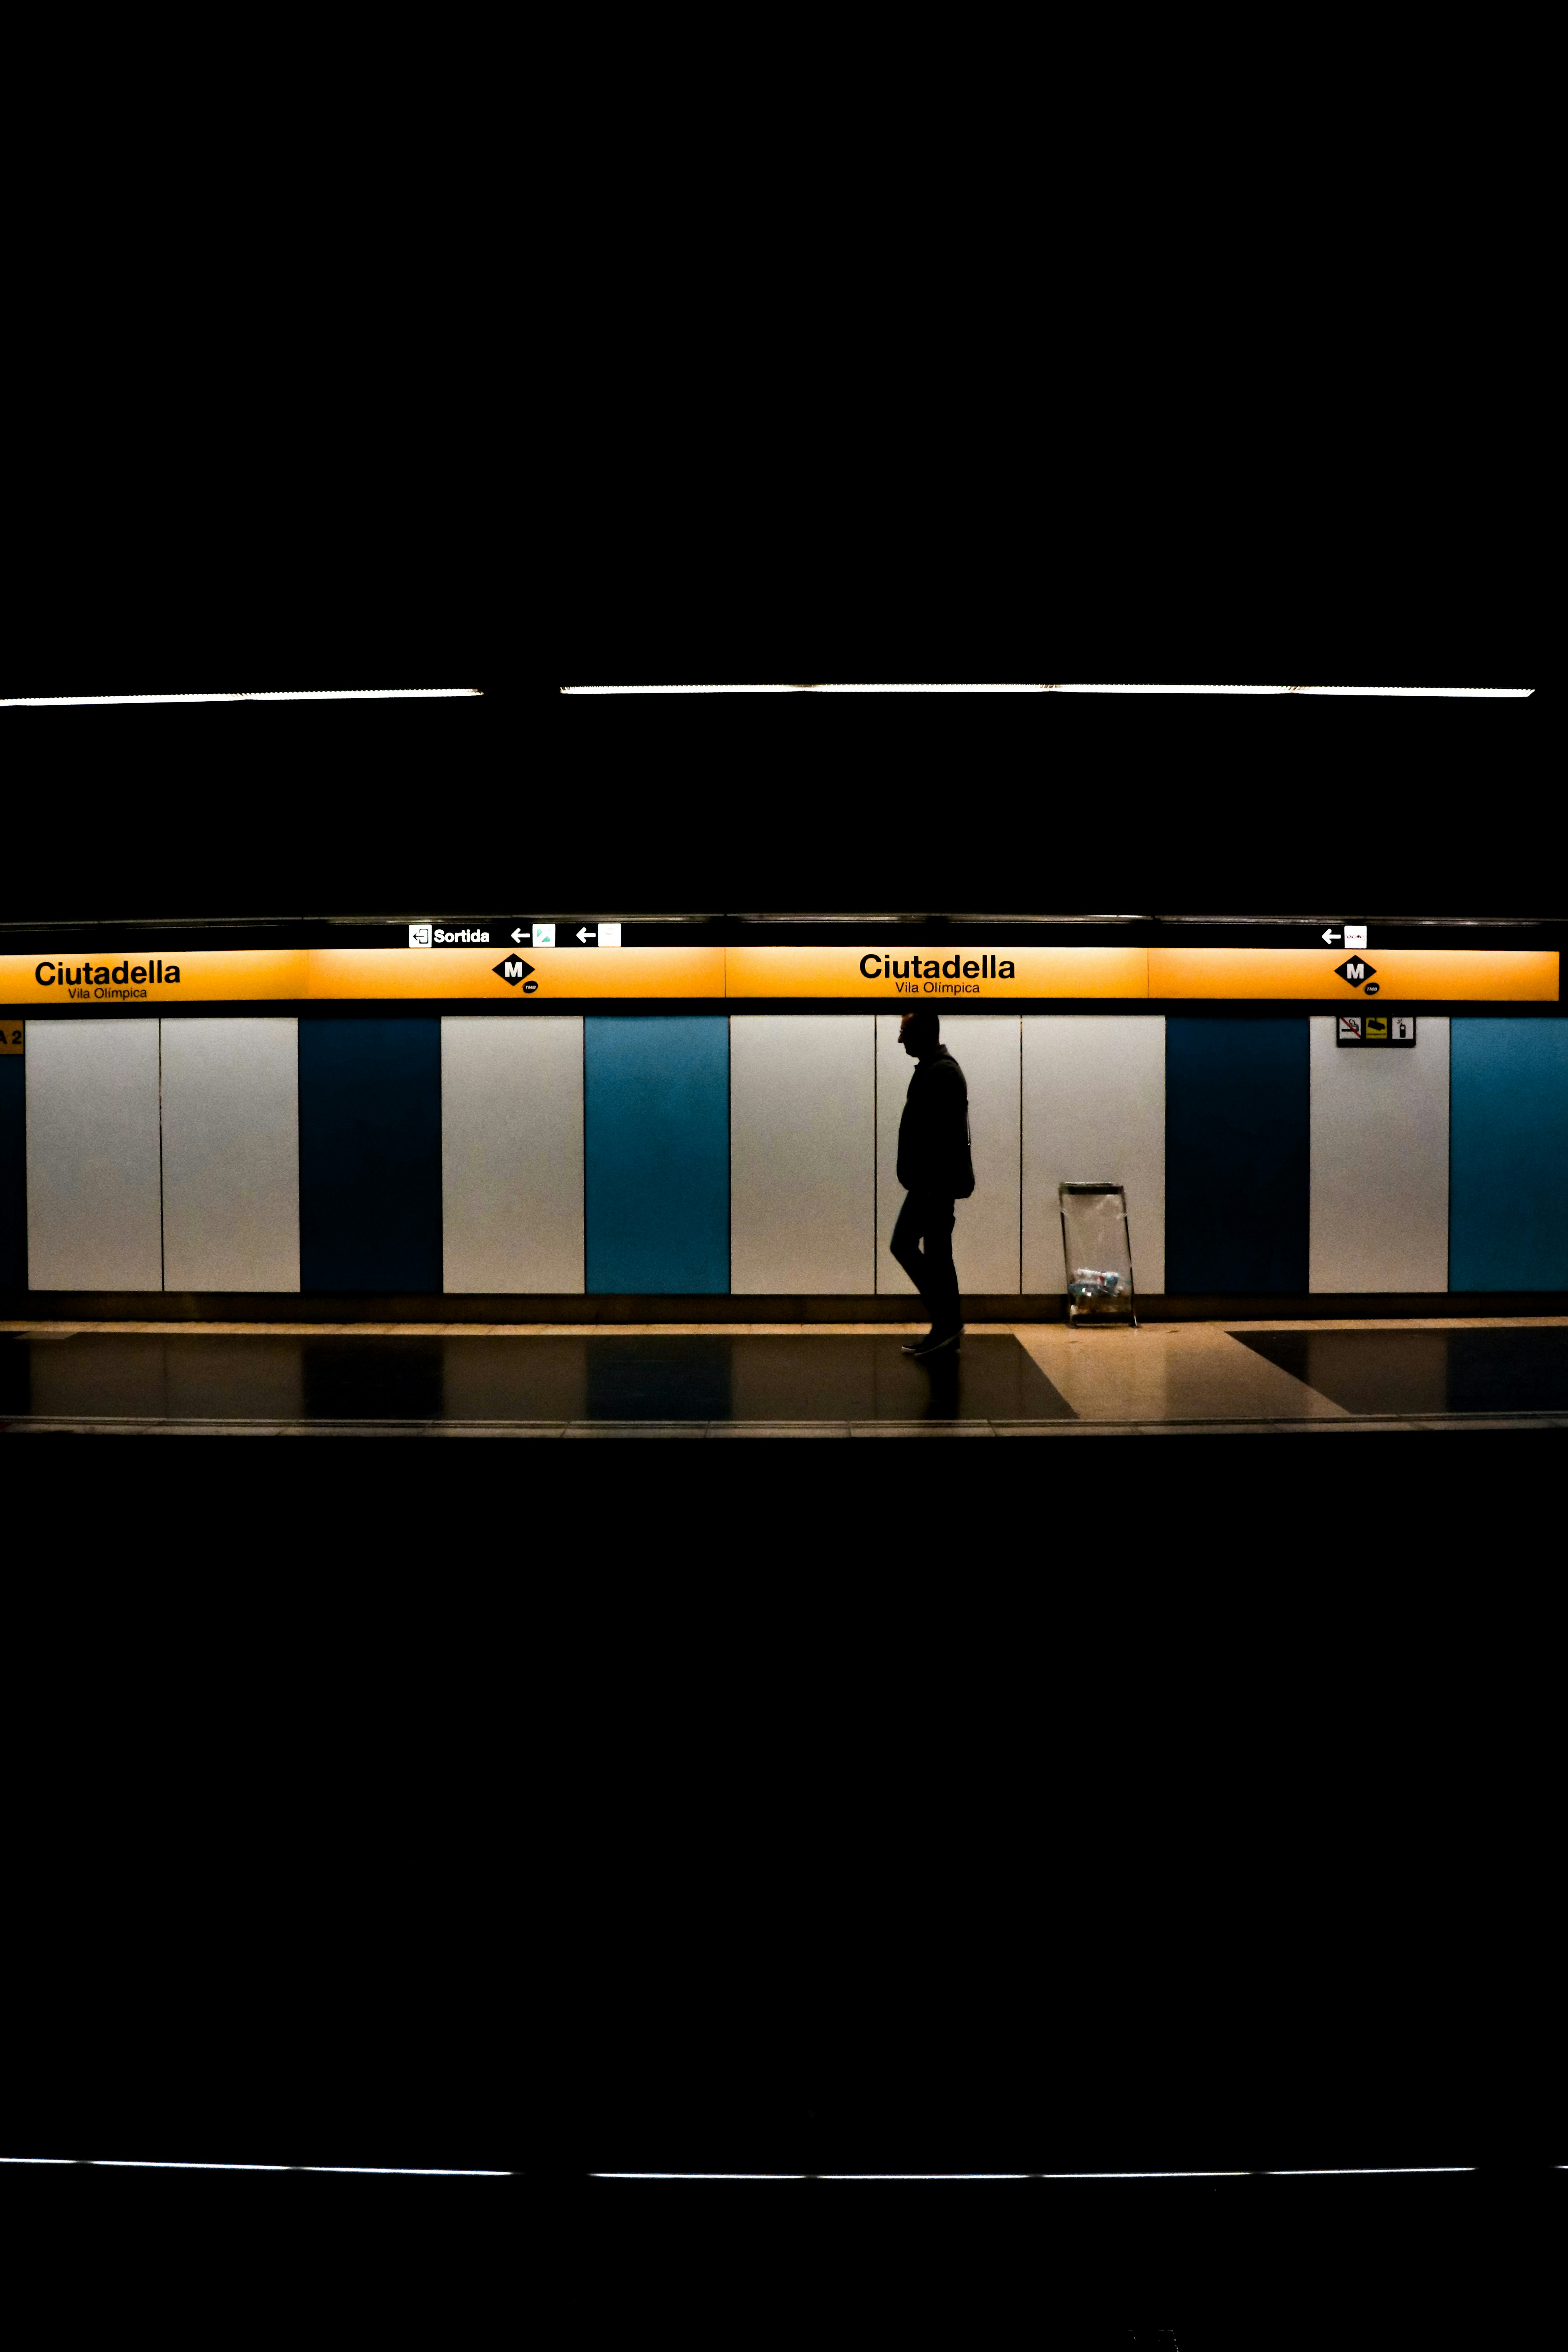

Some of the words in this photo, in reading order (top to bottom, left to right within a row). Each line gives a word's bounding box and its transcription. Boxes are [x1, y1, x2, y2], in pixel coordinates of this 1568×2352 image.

[434, 929, 490, 943] Sortida
[35, 960, 180, 985] Ciutadella
[505, 962, 523, 978] M
[860, 954, 1015, 979] Ciutadella
[1347, 963, 1364, 979] M
[68, 988, 90, 999] Vila
[94, 987, 147, 1000] Olímpica
[895, 982, 919, 993] Vila
[924, 982, 980, 996] Olímpica
[12, 1030, 22, 1044] 2
